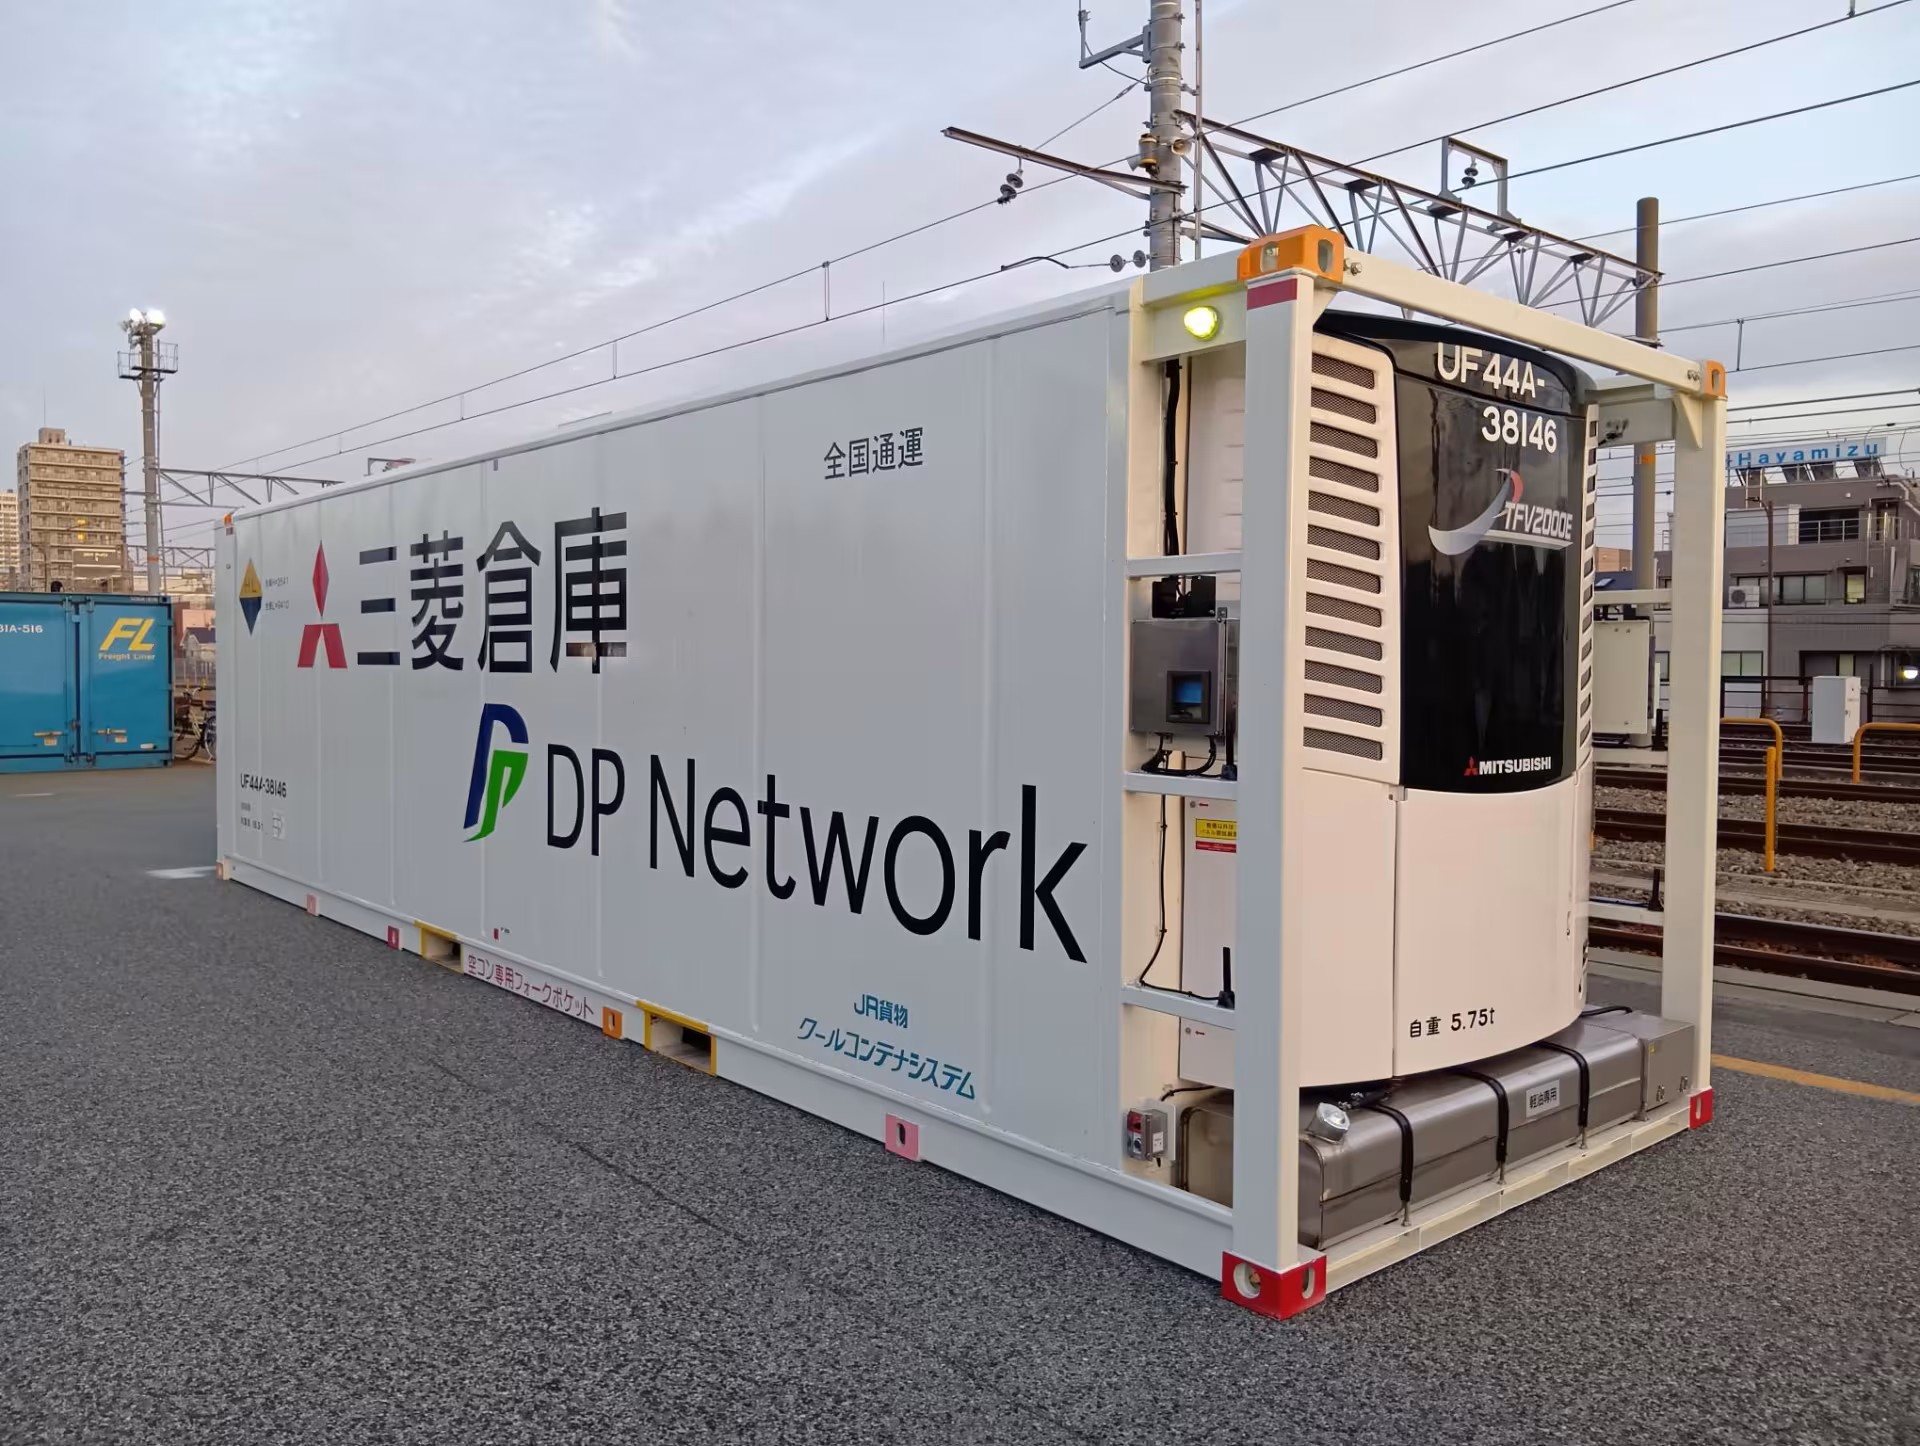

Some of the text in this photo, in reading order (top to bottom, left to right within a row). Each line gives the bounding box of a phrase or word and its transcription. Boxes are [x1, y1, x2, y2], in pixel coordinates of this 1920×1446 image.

[1481, 406, 1558, 453] 38146
[823, 427, 923, 480] 全国通運
[1737, 442, 1878, 467] Hayamizu
[1504, 501, 1574, 541] TFV2000E
[357, 506, 628, 674] 三菱倉庫
[99, 617, 155, 651] FL
[98, 652, 131, 662] Freight
[1479, 756, 1552, 775] MITSUBISHI
[240, 772, 287, 798] UF44A-38146
[547, 743, 1088, 964] DP Network
[467, 953, 595, 1019] 空コン専用フォークポケット
[853, 993, 908, 1028] JR貨物
[1409, 1007, 1496, 1038] 自重 5.75t
[797, 1017, 976, 1100] クールコンテナシステム
